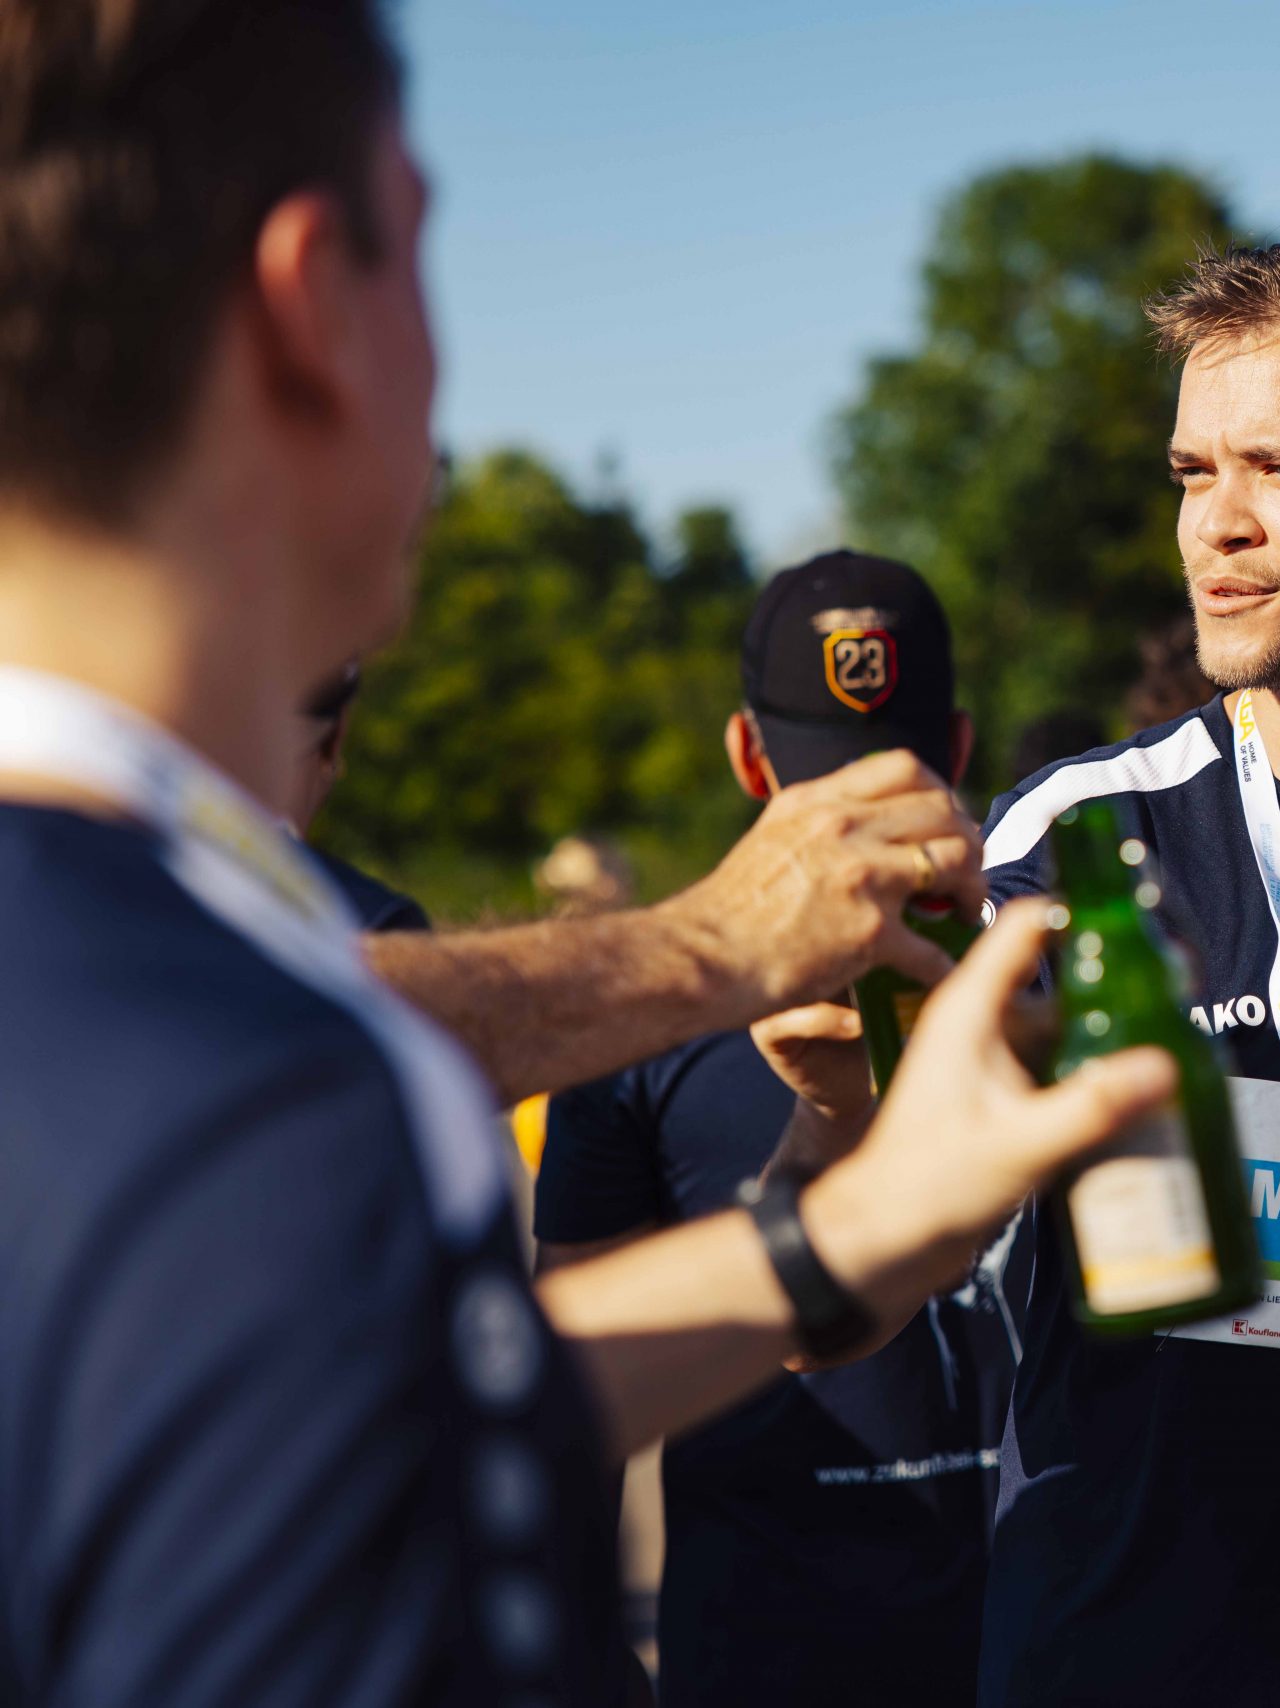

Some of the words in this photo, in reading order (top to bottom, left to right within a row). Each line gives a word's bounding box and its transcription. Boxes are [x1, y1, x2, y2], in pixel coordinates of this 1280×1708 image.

[834, 639, 886, 690] 23
[1240, 745, 1246, 755] OF
[1248, 741, 1257, 764] HOME
[1242, 756, 1251, 783] VALUES
[1189, 994, 1266, 1037] AKO
